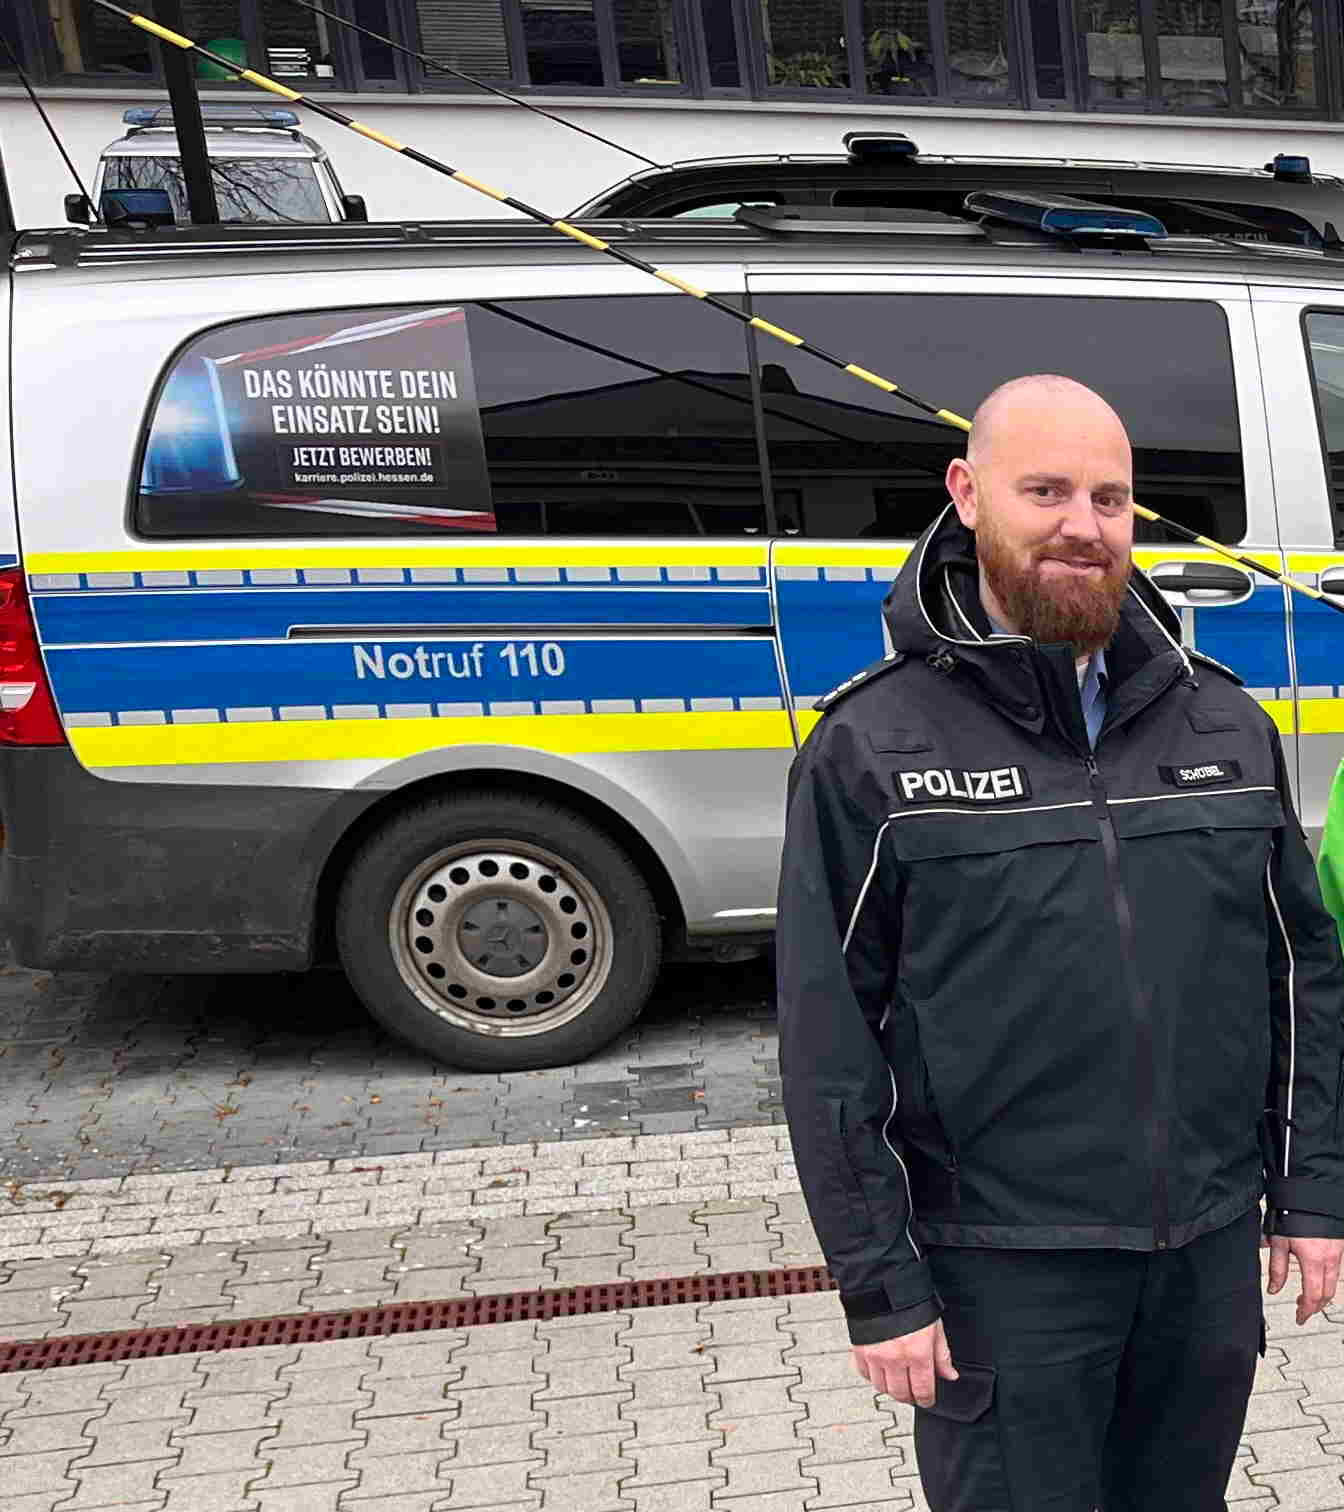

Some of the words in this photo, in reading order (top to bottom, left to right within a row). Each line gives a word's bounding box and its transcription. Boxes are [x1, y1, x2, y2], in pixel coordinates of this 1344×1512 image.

[243, 369, 293, 399] DAS
[298, 363, 396, 399] KÖNNTE
[399, 369, 458, 399] DEIN
[272, 405, 373, 434] EINSATZ
[375, 405, 441, 434] SEIN!
[293, 447, 335, 467] JETZT
[340, 447, 432, 467] BEWERBEN!
[294, 471, 434, 484] karriere.polizei.hessen.de
[353, 643, 485, 681] Notruf
[498, 642, 567, 679] 110
[900, 766, 1024, 801] POLIZEI
